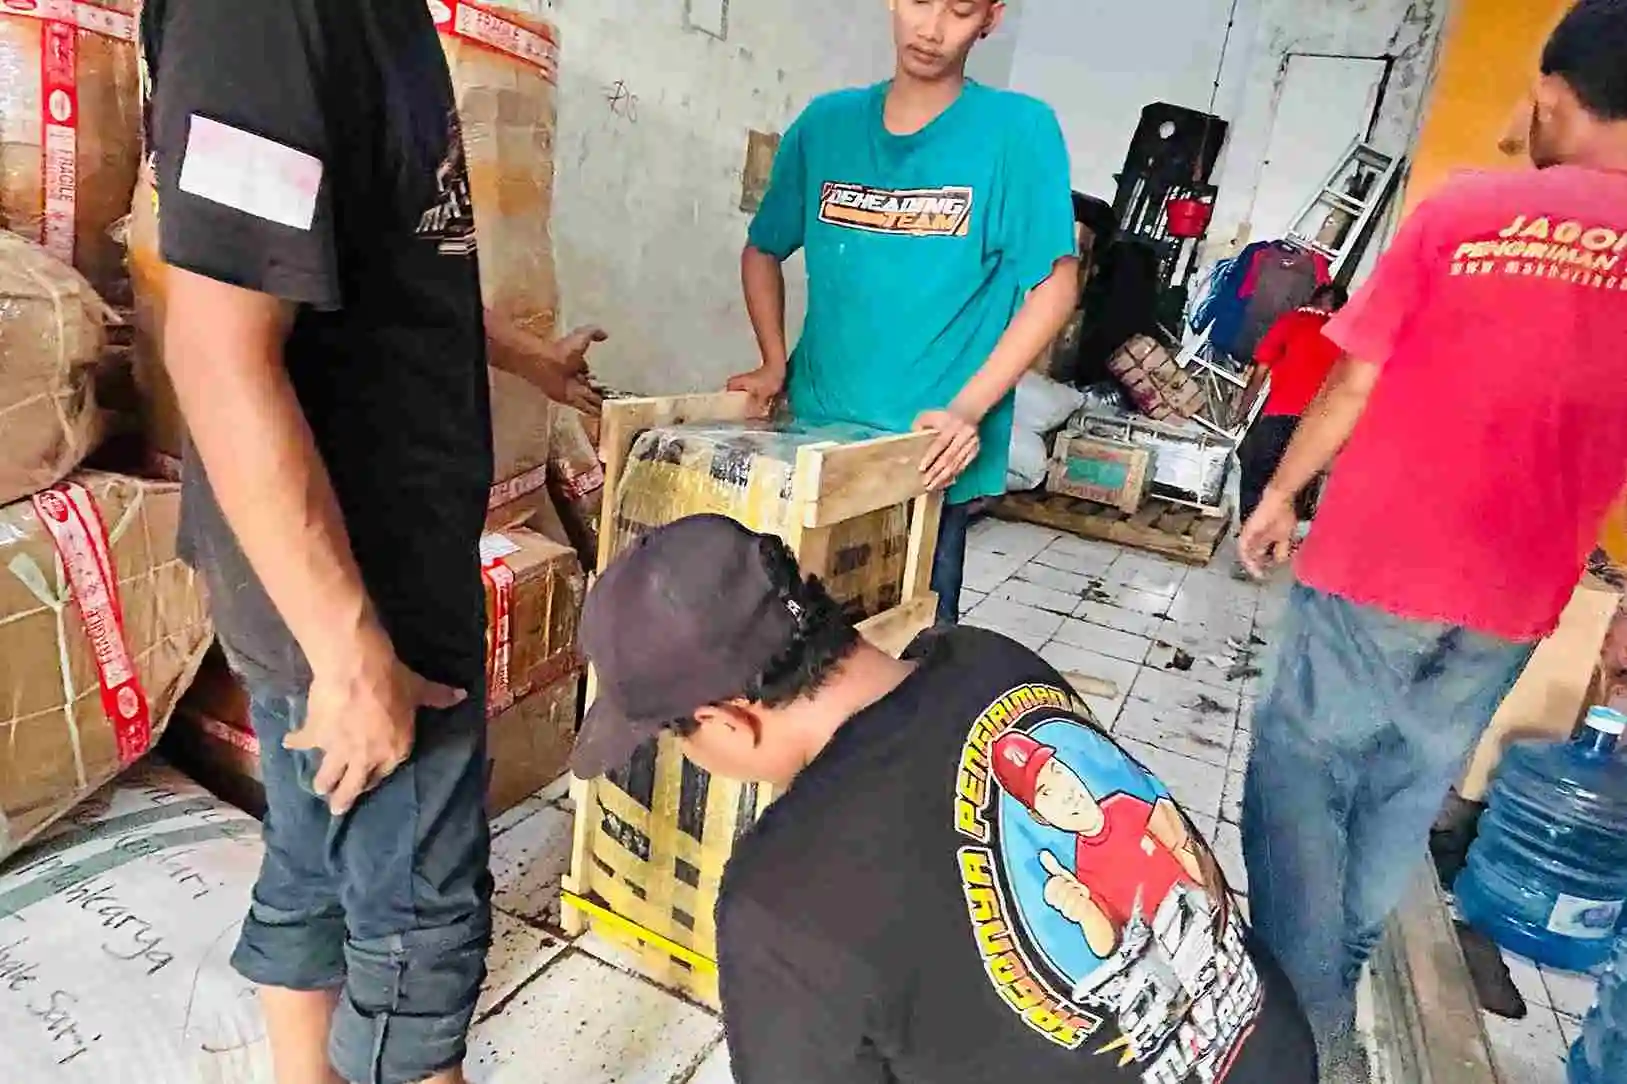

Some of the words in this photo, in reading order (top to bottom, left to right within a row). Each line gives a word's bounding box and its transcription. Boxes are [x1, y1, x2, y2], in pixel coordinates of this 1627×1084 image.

[59, 147, 76, 202] FRAGILE
[882, 212, 956, 230] TEAM
[1499, 214, 1627, 254] JAGO
